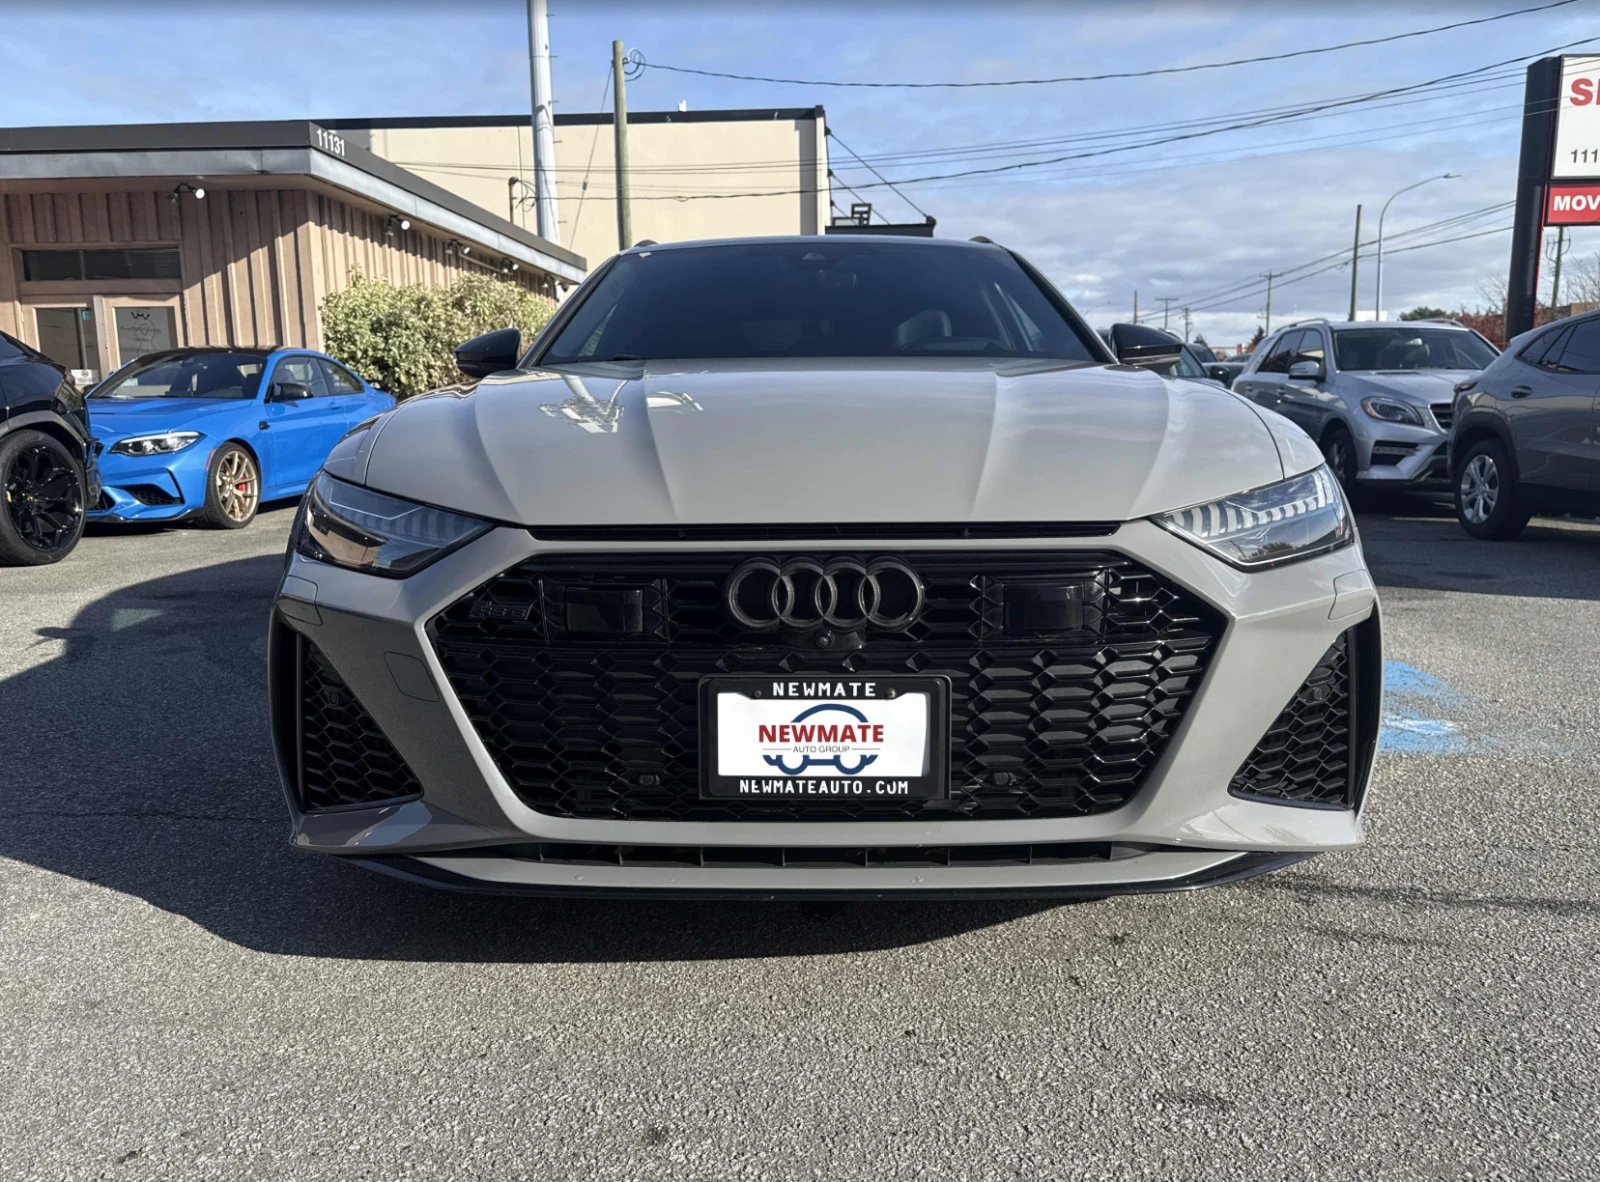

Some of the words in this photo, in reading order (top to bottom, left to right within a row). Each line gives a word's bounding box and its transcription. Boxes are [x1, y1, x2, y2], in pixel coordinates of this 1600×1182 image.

[1569, 77, 1600, 107] S
[316, 128, 345, 157] 11131
[772, 682, 876, 697] NEWMATE
[758, 724, 884, 743] NEWMATE
[792, 745, 817, 753] AUTO
[818, 745, 850, 753] GROUP
[739, 780, 909, 795] NEWMATEAUTO.COM
